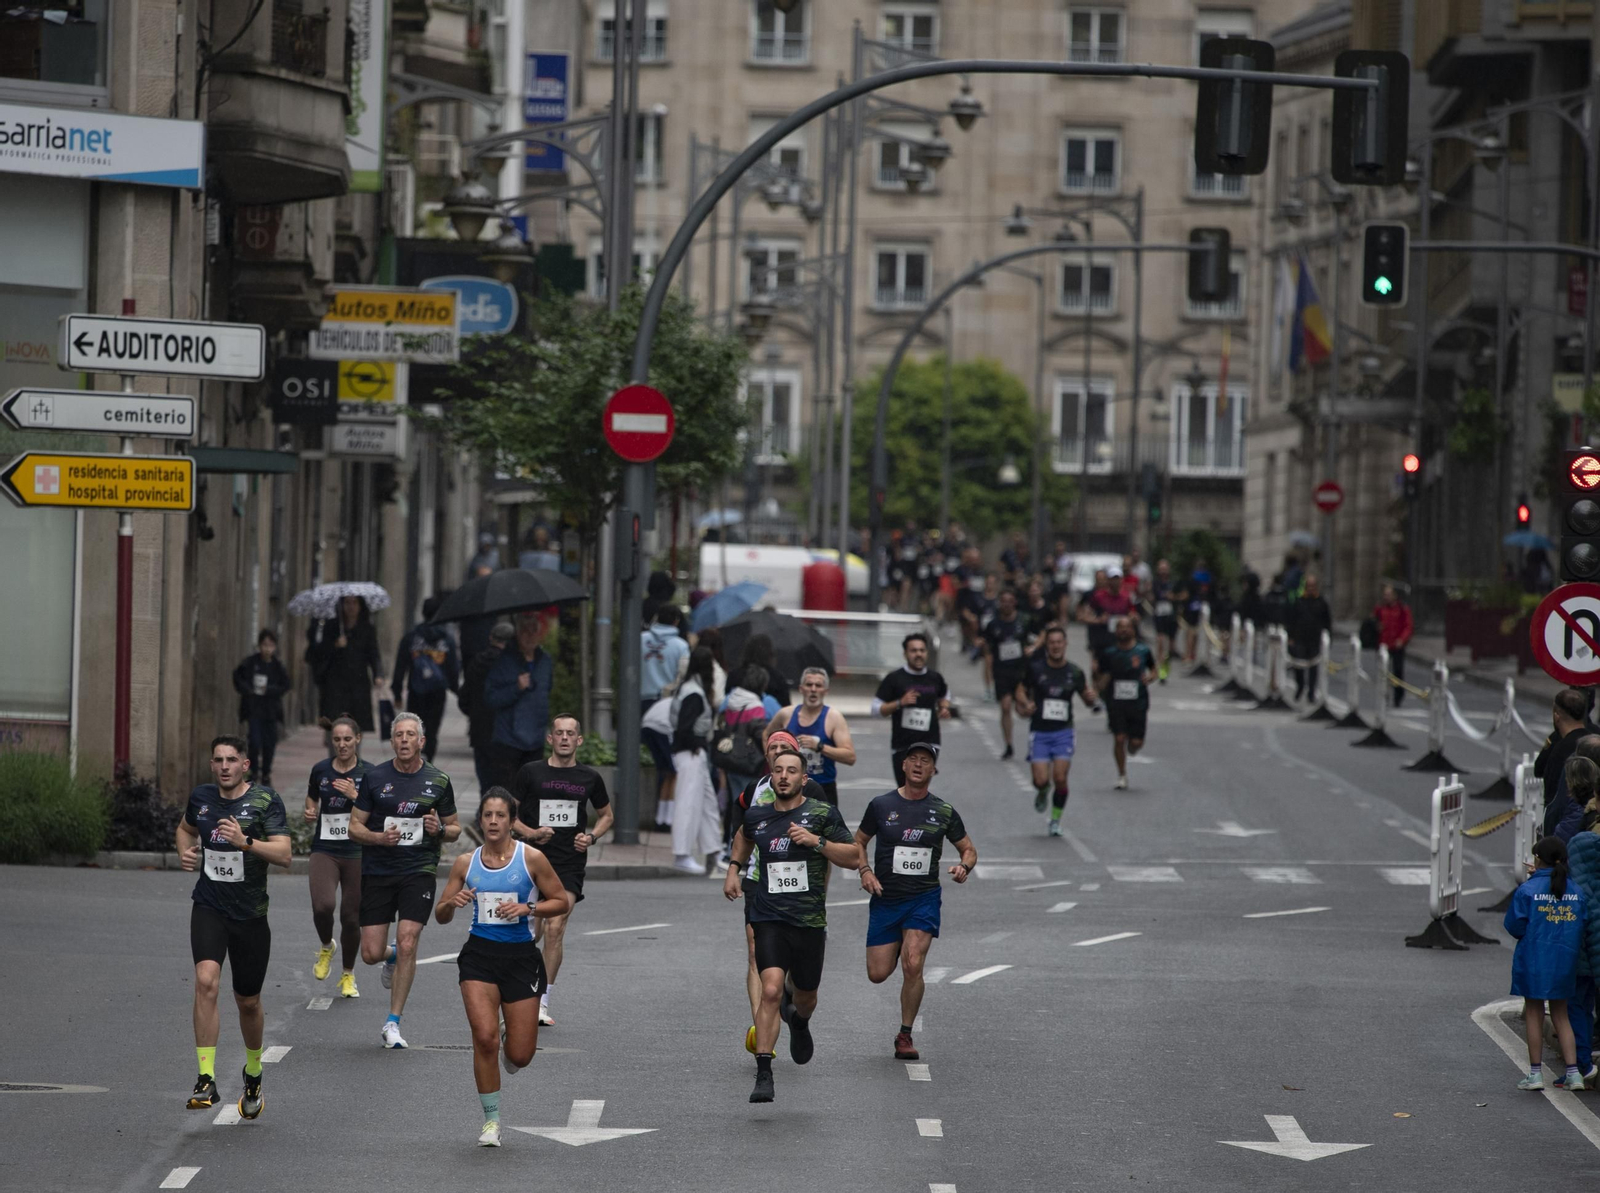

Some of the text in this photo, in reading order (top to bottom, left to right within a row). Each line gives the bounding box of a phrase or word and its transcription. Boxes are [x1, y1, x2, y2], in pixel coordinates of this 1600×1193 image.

[327, 300, 450, 321] Autos Miño
[98, 330, 216, 364] AUDITORIO
[282, 376, 331, 398] OSI
[104, 407, 187, 425] cemiterio
[68, 463, 185, 483] residencia sanitaria
[68, 483, 185, 503] hospital provincial
[549, 813, 569, 822] 519
[329, 826, 347, 836] 608
[400, 831, 414, 841] 42
[213, 866, 234, 877] 154
[902, 861, 922, 870] 660
[777, 877, 798, 888] 368
